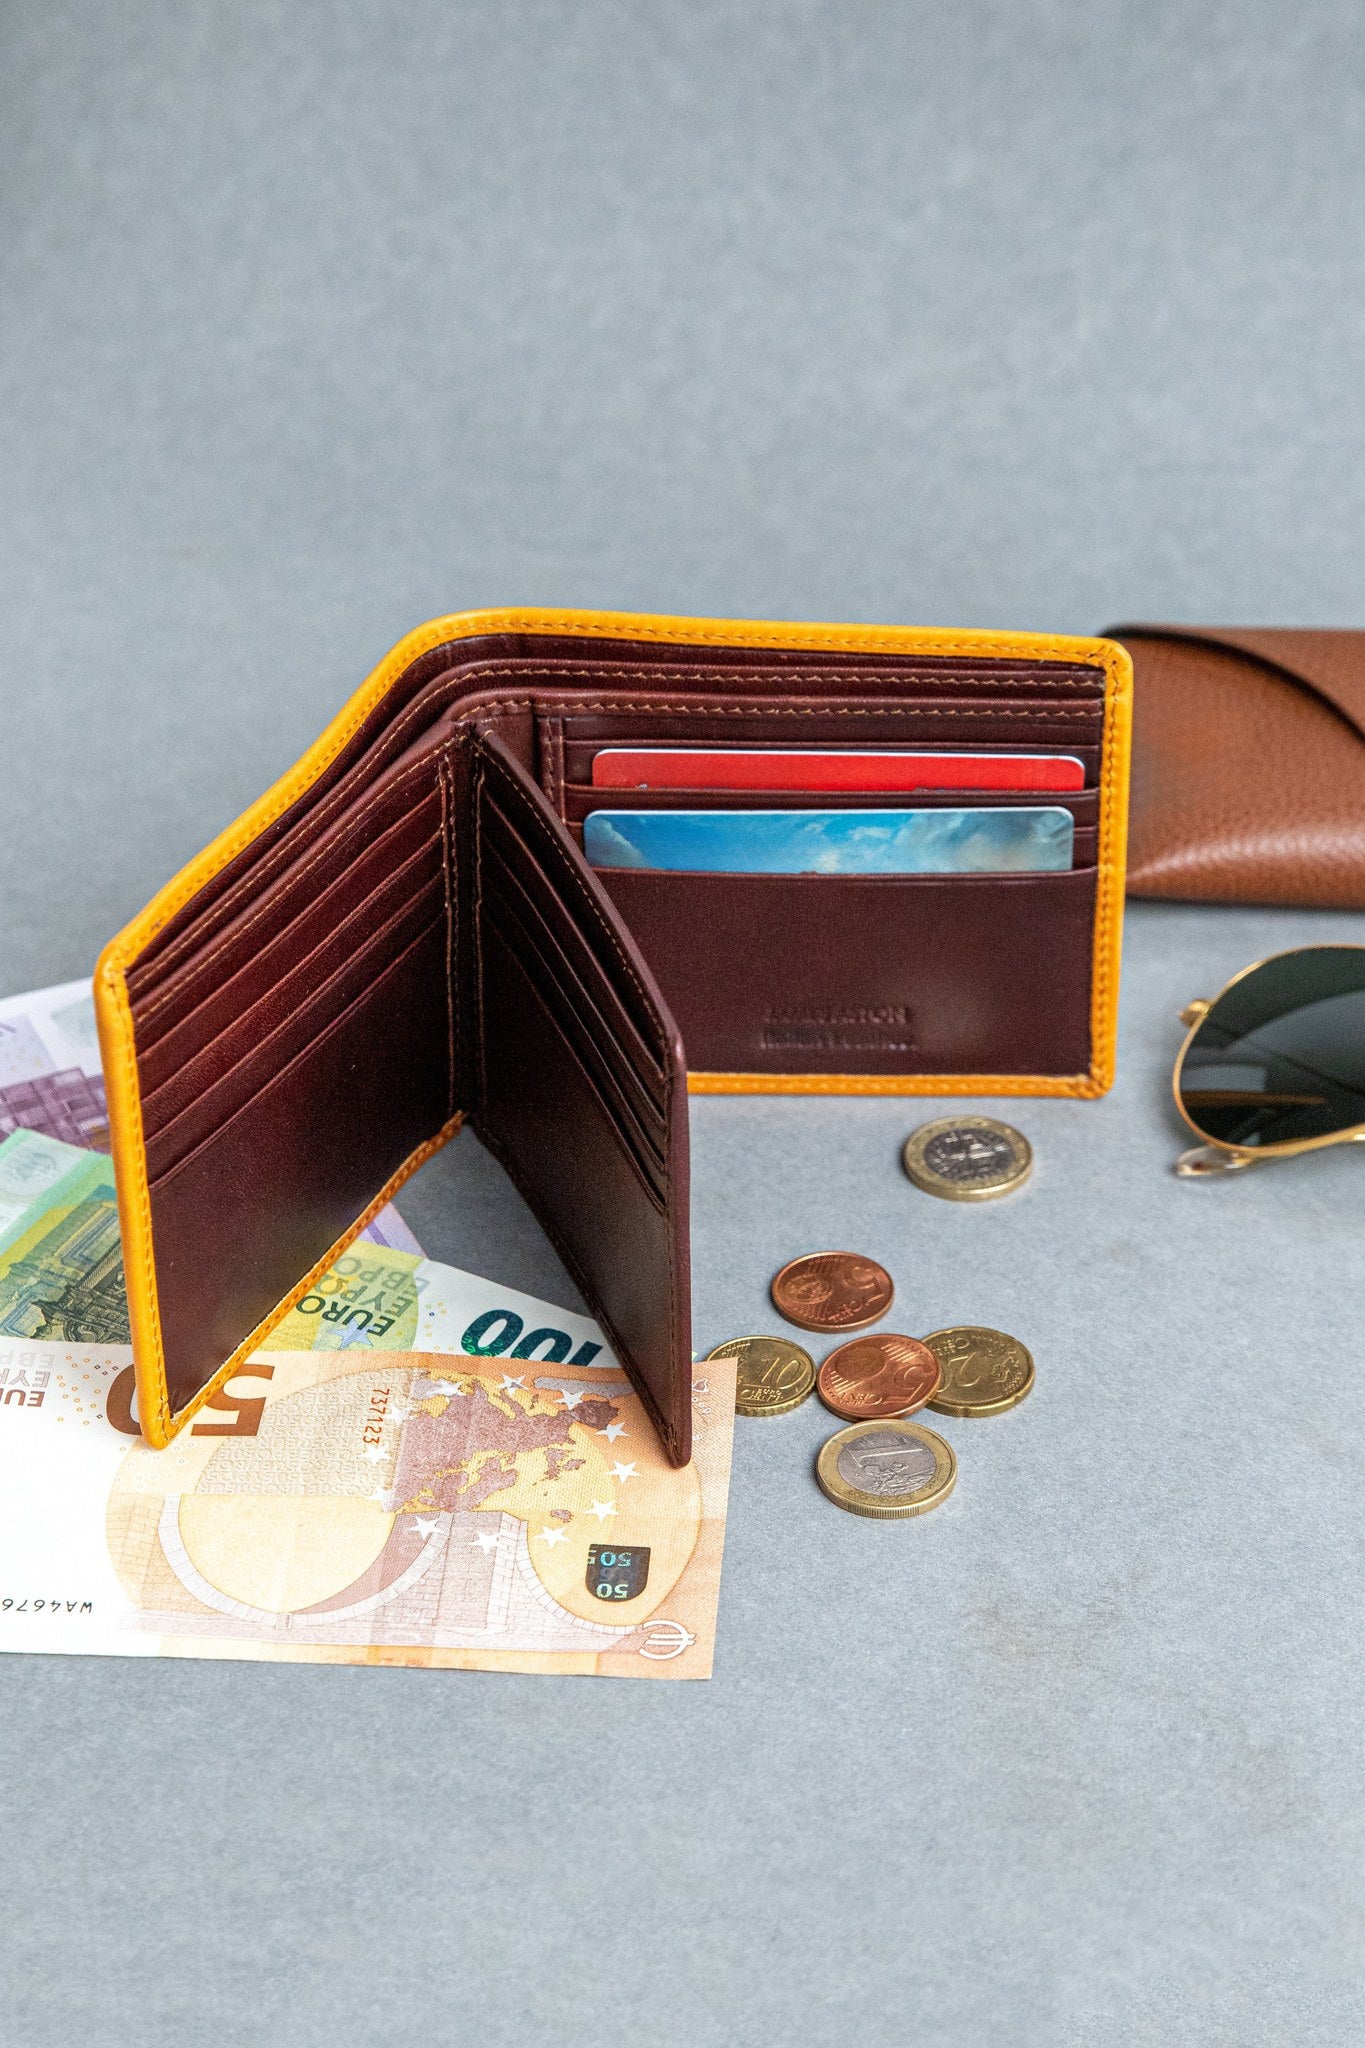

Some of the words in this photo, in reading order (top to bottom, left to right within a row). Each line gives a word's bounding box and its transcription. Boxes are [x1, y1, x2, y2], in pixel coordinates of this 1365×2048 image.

[295, 1295, 396, 1337] EURO
[751, 1356, 807, 1390] 10
[0, 1387, 45, 1407] EU
[362, 1388, 390, 1444] 737123
[600, 1551, 632, 1567] 50
[596, 1583, 629, 1599] 50
[1, 1598, 93, 1614] WA4676
